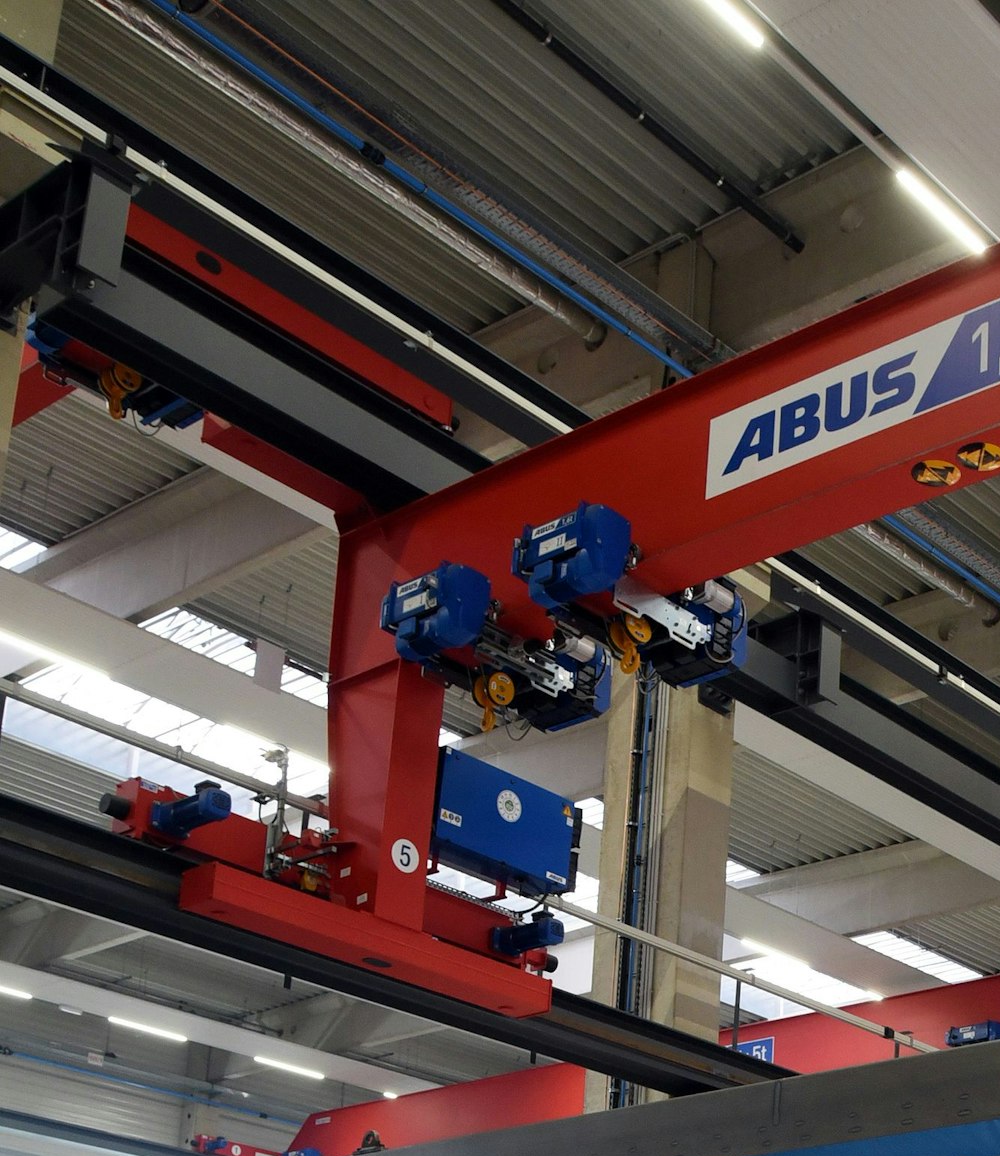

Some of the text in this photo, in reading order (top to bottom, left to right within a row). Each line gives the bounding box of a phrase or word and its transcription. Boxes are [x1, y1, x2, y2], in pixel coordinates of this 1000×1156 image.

[722, 350, 918, 477] ABUS
[534, 522, 556, 537] ABUS
[400, 582, 418, 595] ABUS
[400, 845, 411, 867] 5
